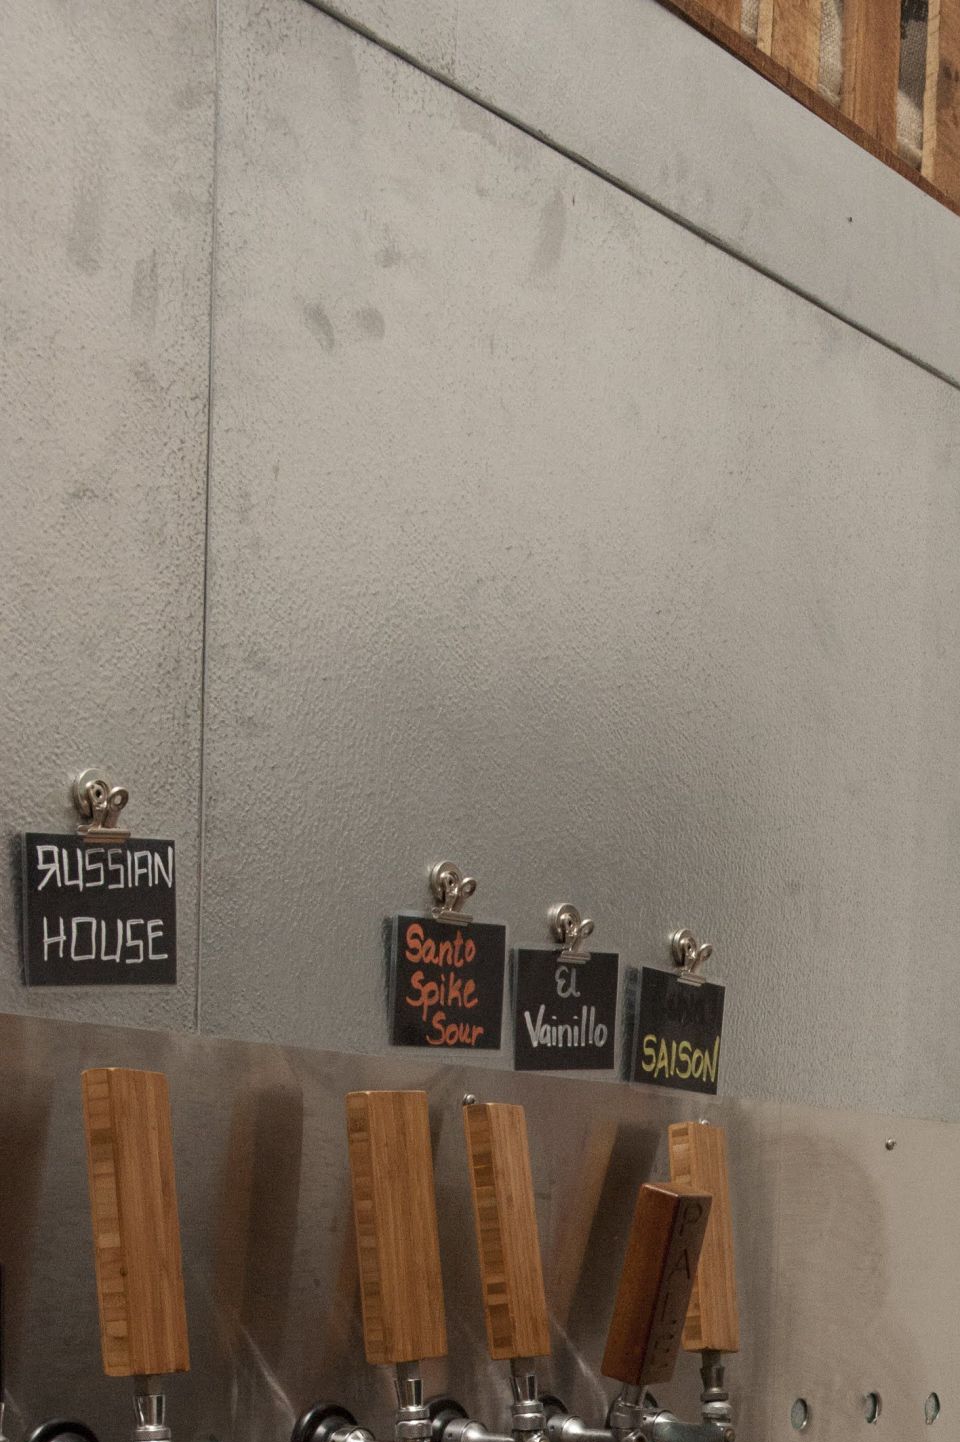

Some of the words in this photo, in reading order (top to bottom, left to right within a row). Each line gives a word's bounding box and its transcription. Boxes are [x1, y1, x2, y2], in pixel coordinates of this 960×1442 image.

[43, 916, 169, 964] HOUSE
[405, 923, 477, 968] Santo
[406, 970, 479, 1022] Spike
[555, 965, 581, 998] El
[426, 1010, 485, 1046] Sour
[524, 1003, 609, 1048] Vainillo
[641, 1033, 720, 1083] SAISON
